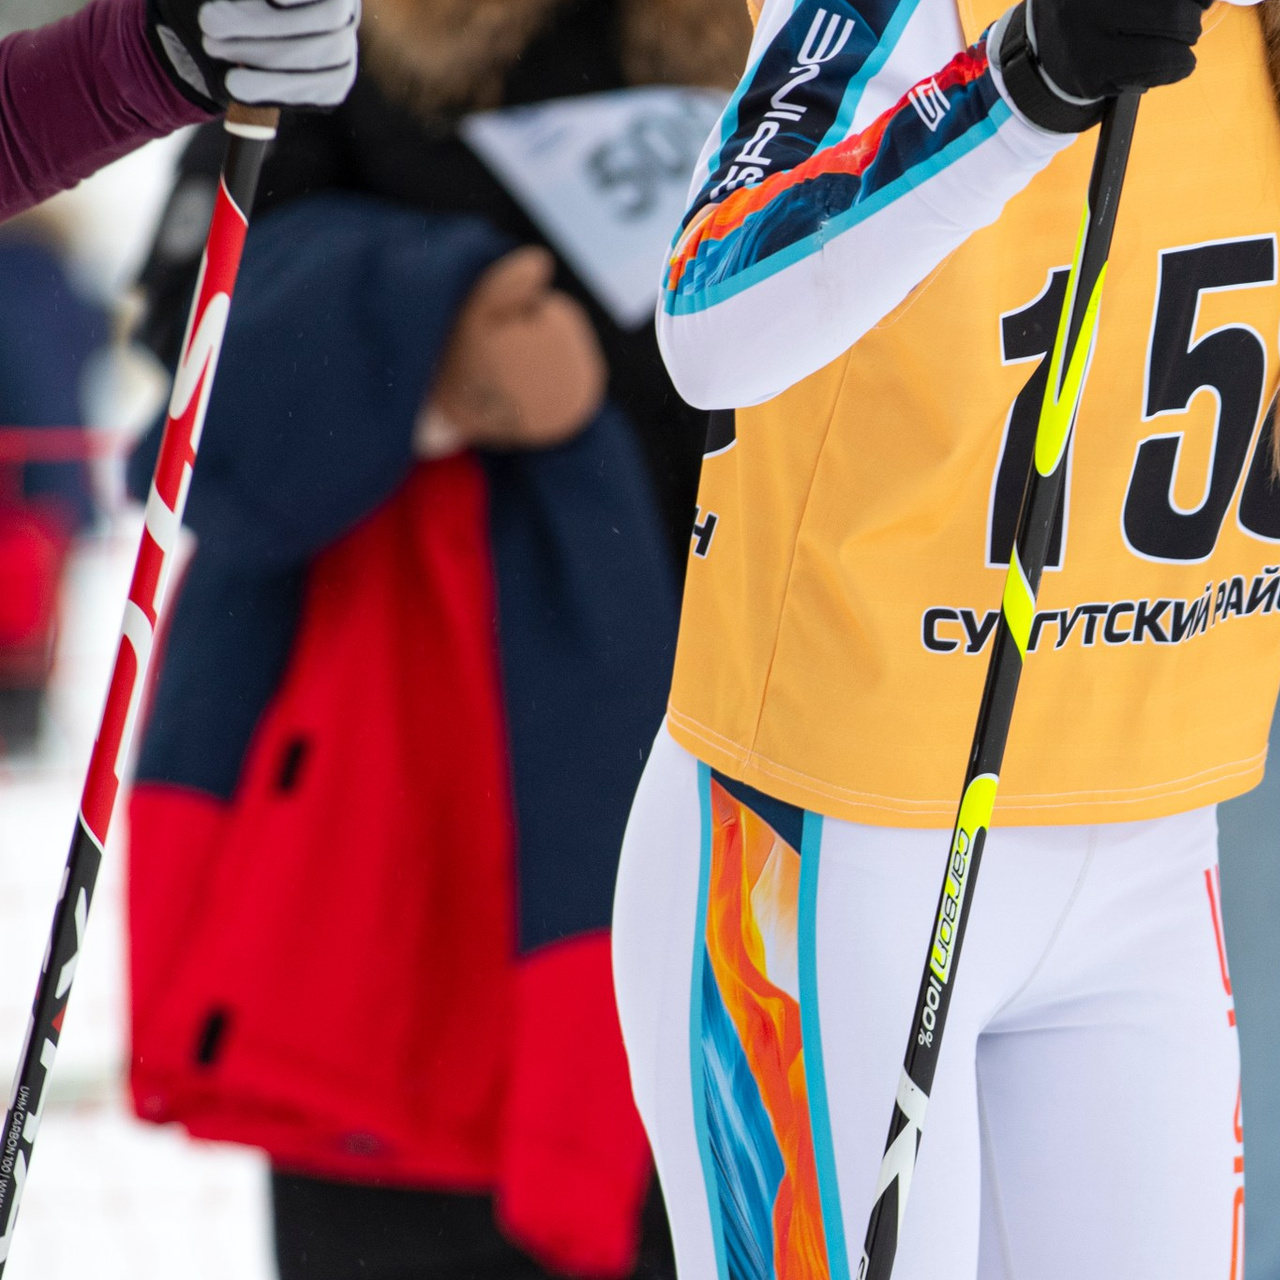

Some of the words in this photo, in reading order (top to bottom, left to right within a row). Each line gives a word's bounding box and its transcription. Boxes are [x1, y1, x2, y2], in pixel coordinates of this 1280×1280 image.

[921, 580, 1213, 654] СУГУТСКИЙ
[917, 974, 943, 1049] 100%
[17, 1085, 30, 1113] UHM
[7, 1111, 24, 1157] CARBON
[1, 1154, 14, 1175] 100
